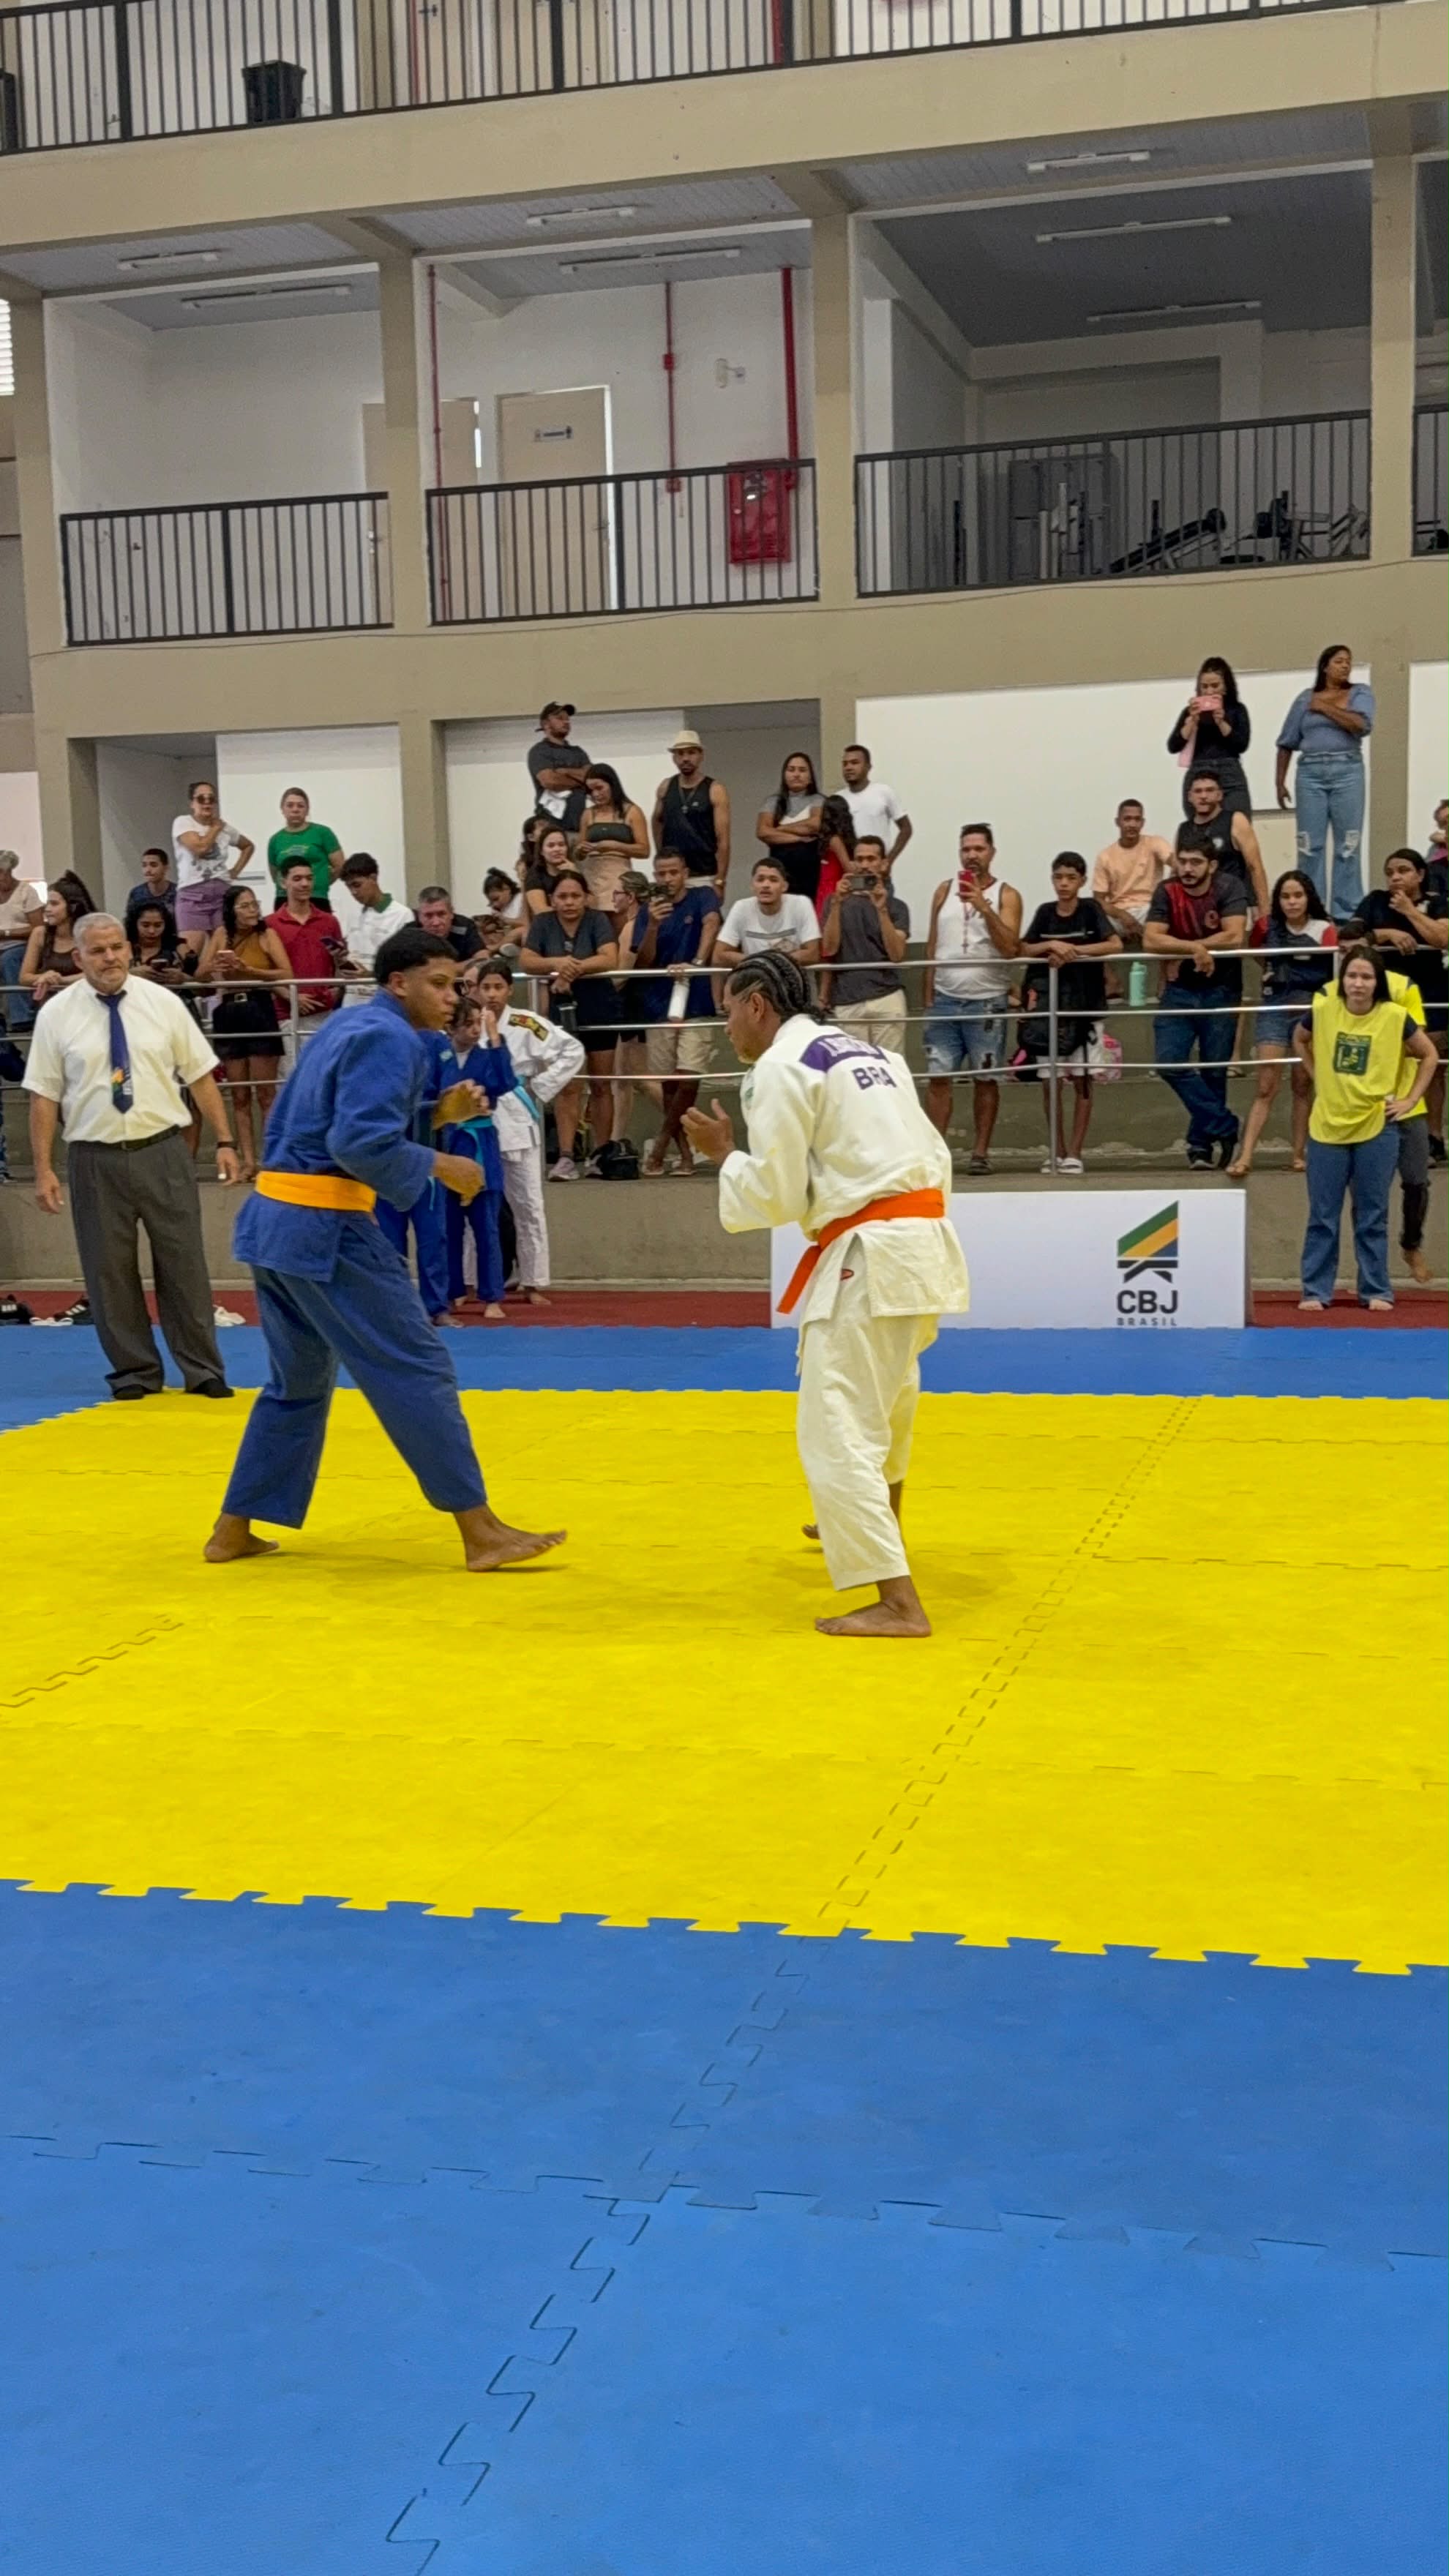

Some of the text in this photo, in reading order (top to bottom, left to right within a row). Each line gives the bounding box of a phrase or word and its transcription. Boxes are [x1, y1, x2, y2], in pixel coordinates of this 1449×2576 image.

[852, 1066, 897, 1090] BRA
[1117, 1289, 1177, 1314] CBJ
[1117, 1317, 1177, 1326] BRASIL
